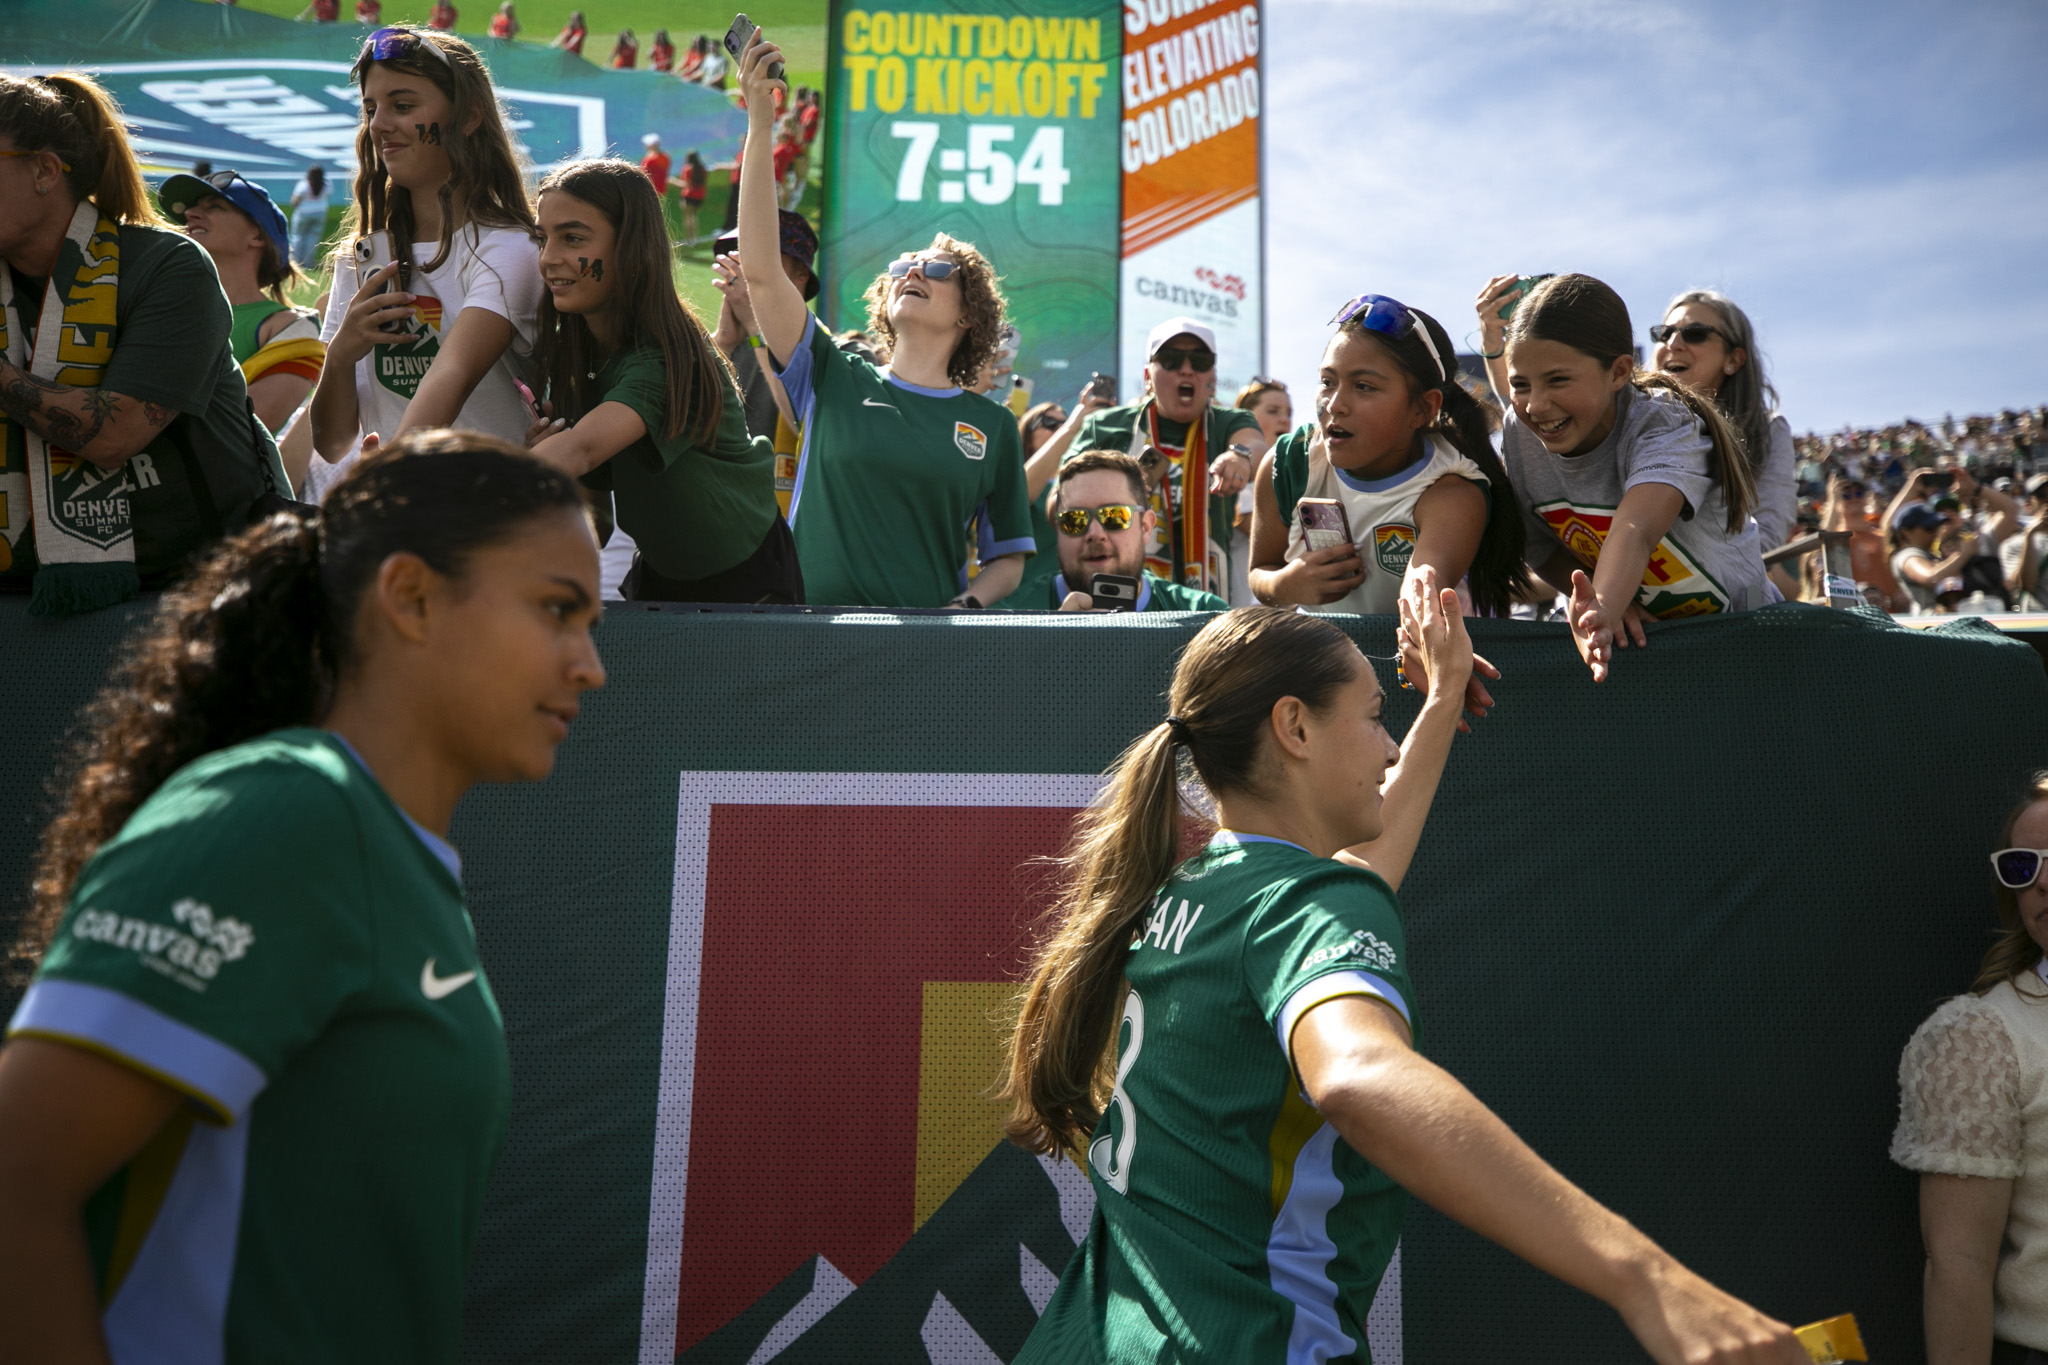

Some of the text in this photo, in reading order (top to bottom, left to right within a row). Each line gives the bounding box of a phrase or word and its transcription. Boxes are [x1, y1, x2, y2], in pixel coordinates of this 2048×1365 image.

[843, 9, 1101, 61] COUNTDOWN
[1122, 4, 1259, 110] ELEVATING
[843, 55, 1108, 119] TO KICKOFF
[1121, 66, 1259, 174] COLORADO
[891, 121, 1070, 206] 7:54
[1136, 277, 1238, 318] canvas
[382, 356, 436, 376] DENVE
[63, 499, 131, 518] DENVE
[75, 515, 131, 527] SUMMIT
[97, 525, 113, 535] FC
[72, 908, 221, 980] canvas
[1301, 940, 1390, 972] canvas
